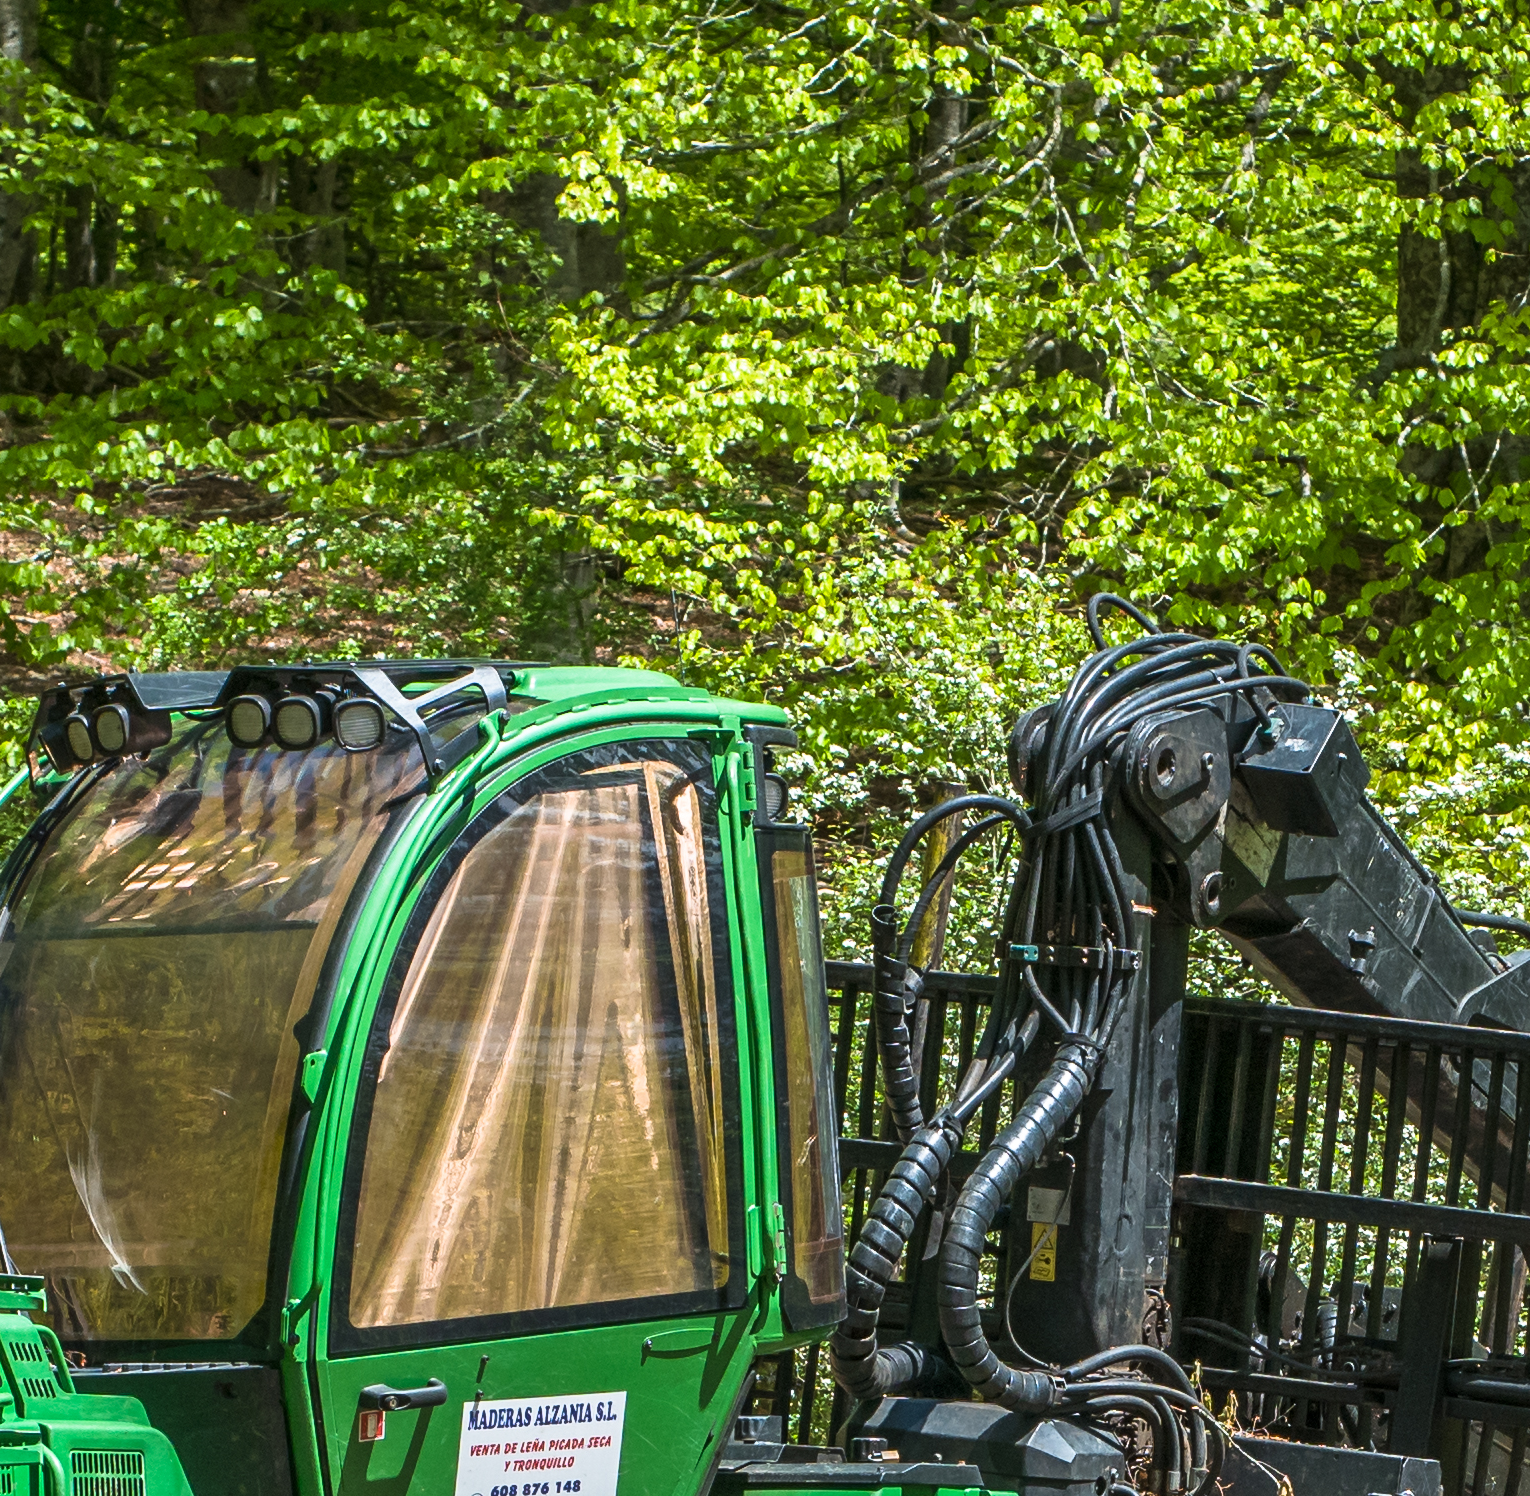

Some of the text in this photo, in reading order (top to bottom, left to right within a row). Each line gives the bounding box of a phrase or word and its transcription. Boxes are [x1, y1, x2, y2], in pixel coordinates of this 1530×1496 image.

[468, 1401, 617, 1431] MADERAS ALZANIA S.L.
[470, 1436, 612, 1457] VENTA DE LEÑA PICADA SECA
[504, 1456, 575, 1472] Y TRONQUILLO
[522, 1482, 549, 1496] 876
[555, 1480, 581, 1493] 148
